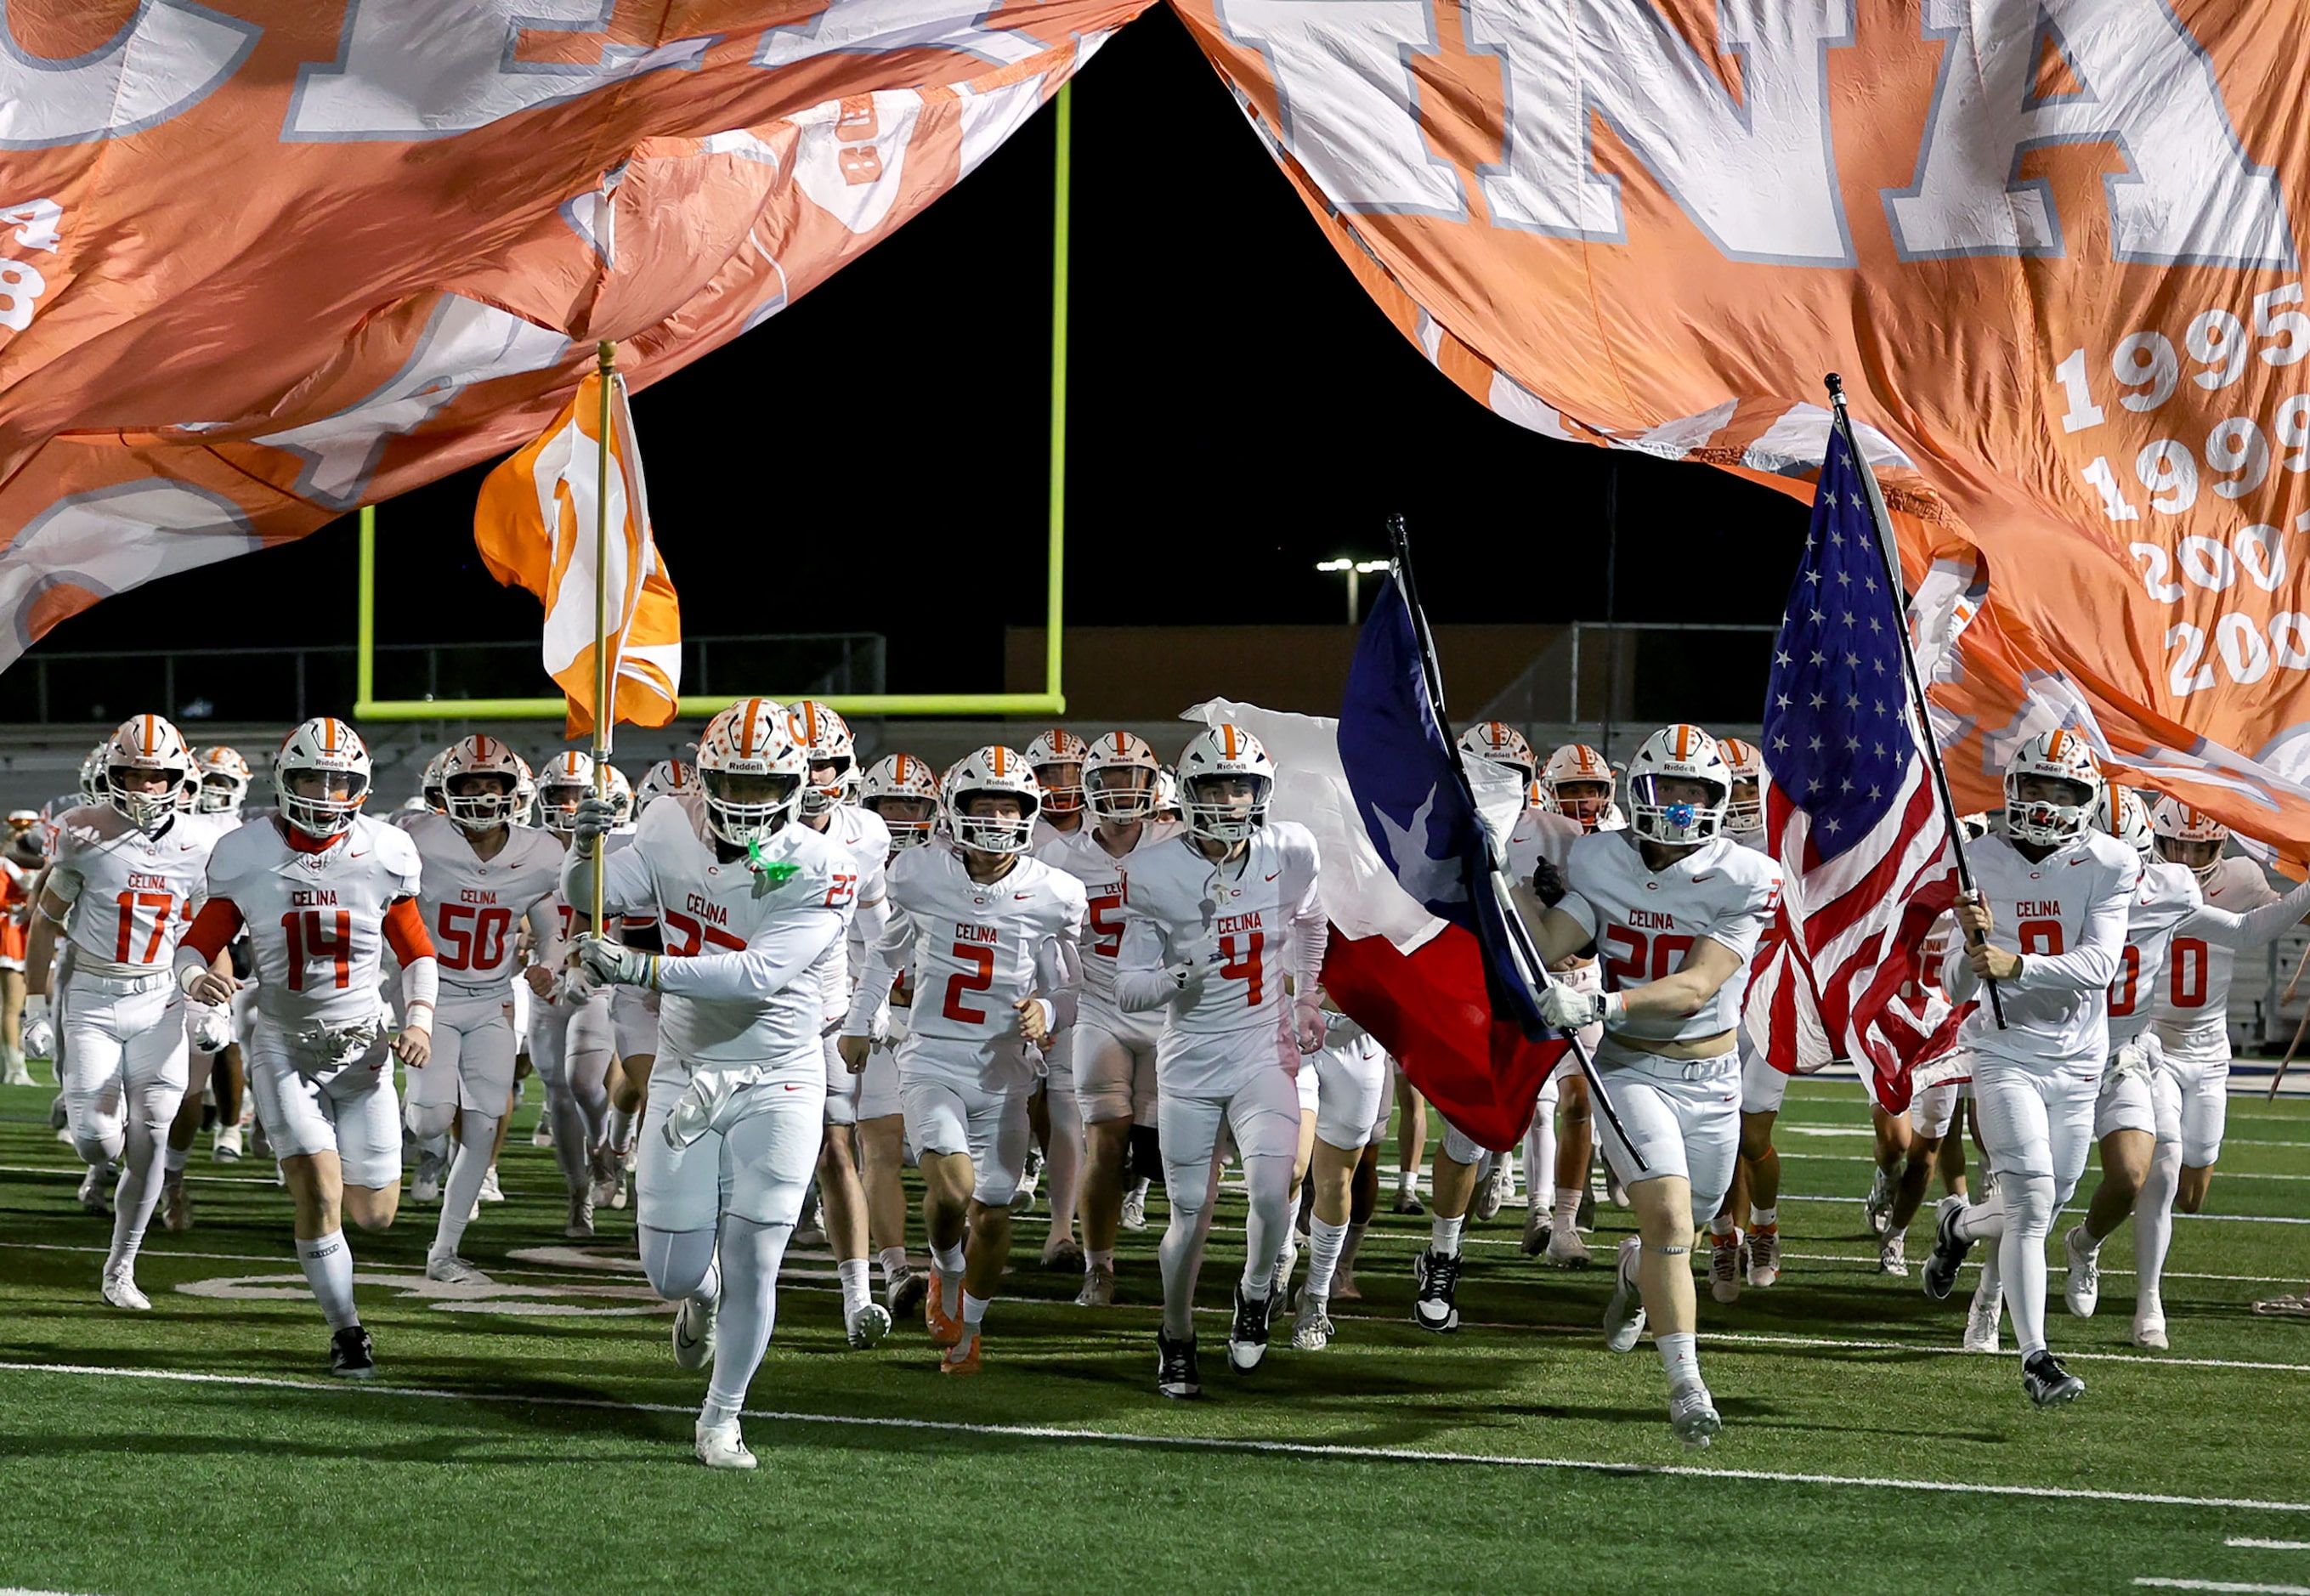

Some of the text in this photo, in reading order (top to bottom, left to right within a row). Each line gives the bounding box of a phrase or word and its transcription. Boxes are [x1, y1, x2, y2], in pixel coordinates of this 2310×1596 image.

[2055, 282, 2310, 433] 1995
[2129, 508, 2310, 603] 200
[729, 762, 763, 771] Riddell
[986, 779, 1015, 788] Riddell
[127, 874, 166, 890] CELINA
[292, 890, 338, 907] CELINA
[461, 889, 497, 905] CELINA
[687, 892, 728, 926] CELINA
[2016, 900, 2062, 918] CELINA
[116, 891, 173, 964] 17
[955, 922, 998, 944] CELINA
[1217, 911, 1263, 935] CELINA
[1628, 908, 1675, 931] CELINA
[280, 910, 351, 992] 14
[437, 902, 512, 971] 50
[943, 942, 994, 1025] 2
[1219, 931, 1265, 1007] 4
[2170, 937, 2208, 1008] 0
